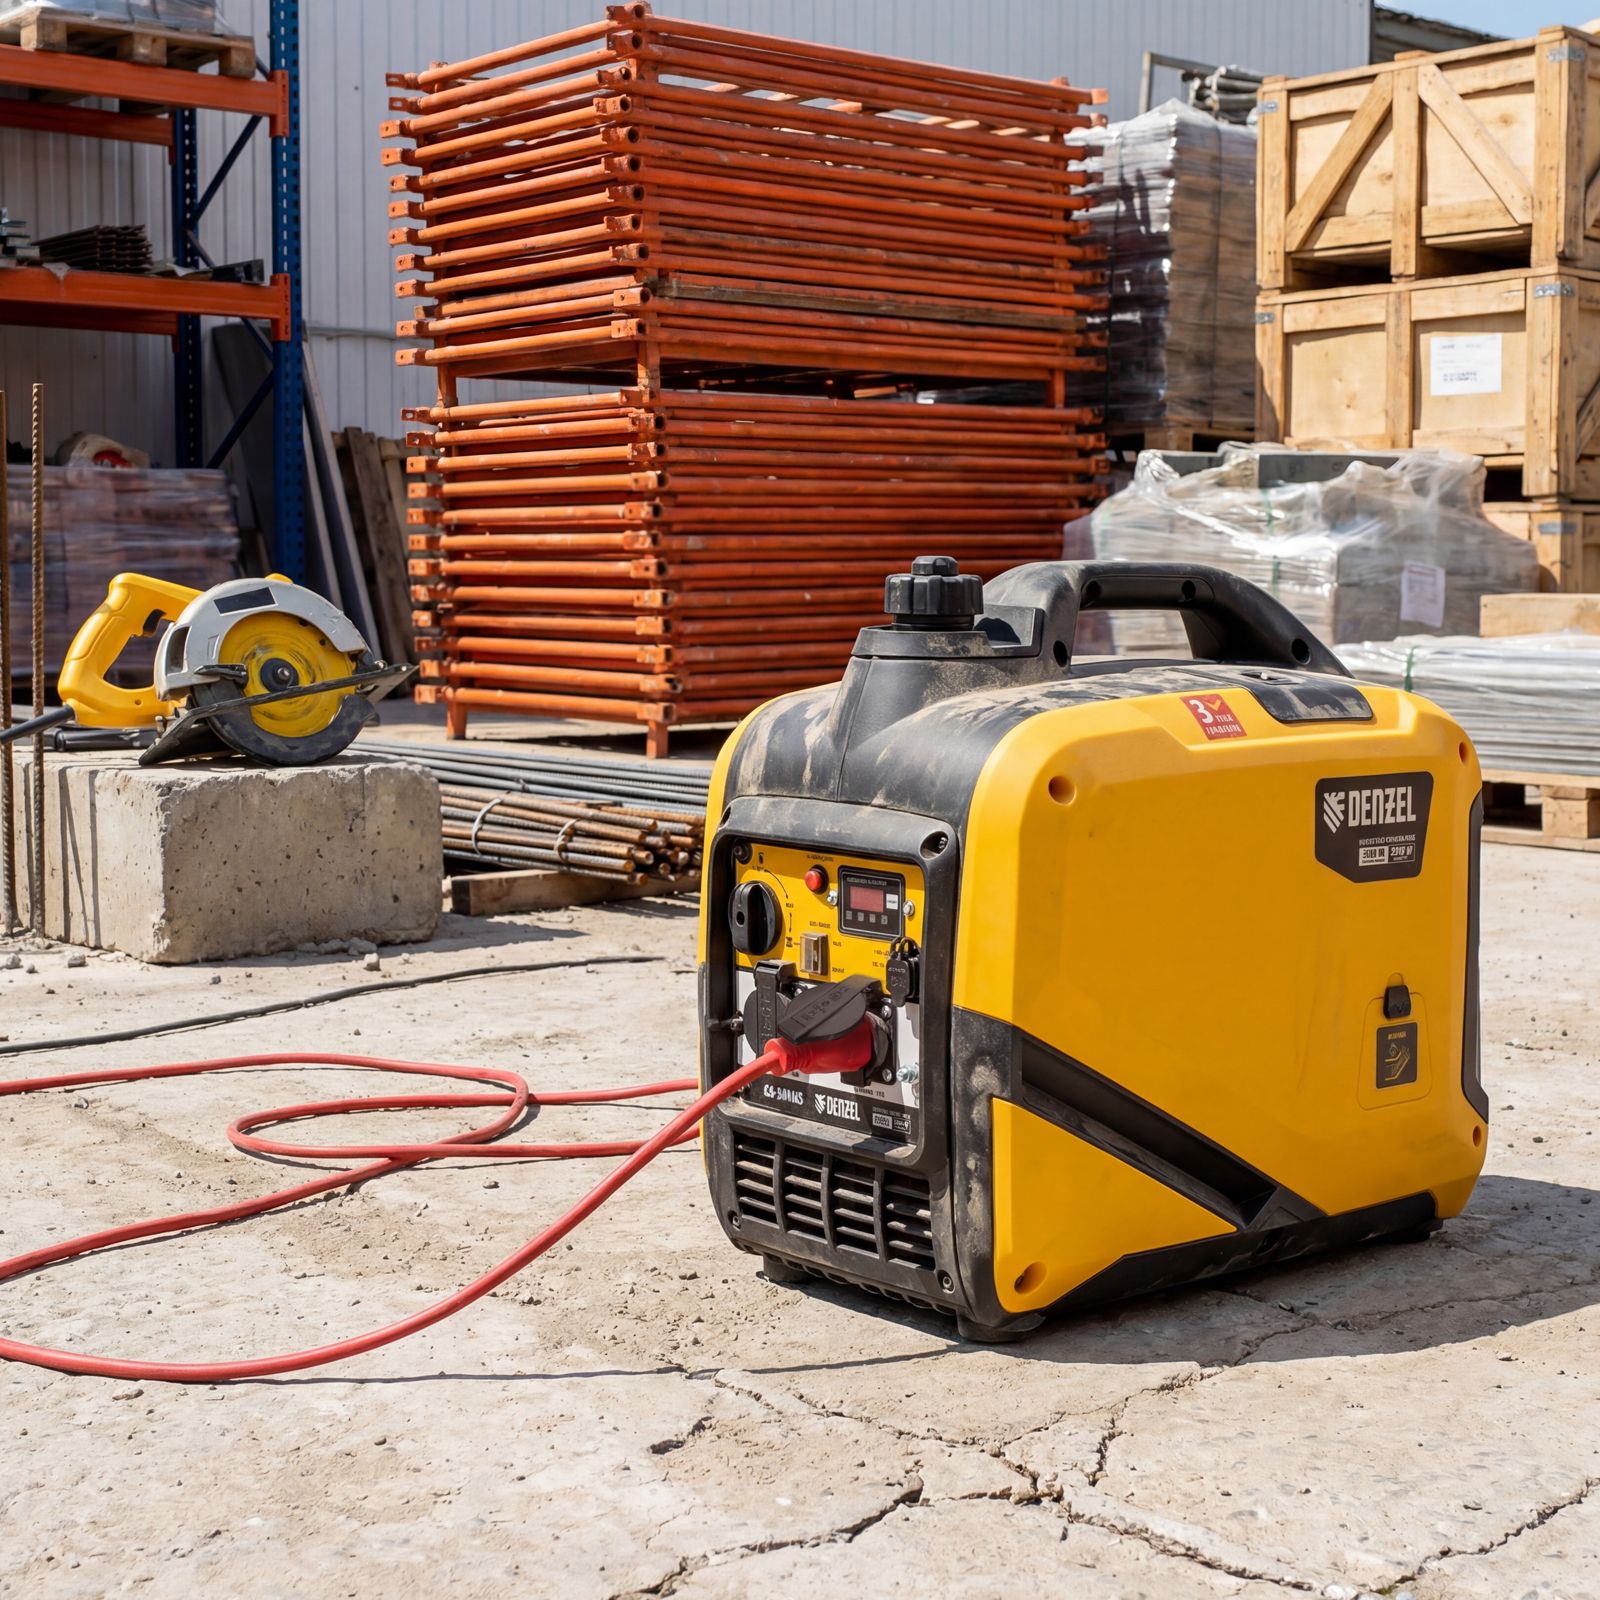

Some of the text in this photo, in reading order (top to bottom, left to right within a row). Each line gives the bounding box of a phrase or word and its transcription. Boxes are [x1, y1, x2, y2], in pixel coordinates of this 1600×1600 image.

[1188, 699, 1214, 724] 3
[1348, 786, 1417, 828] DENZEL
[826, 1095, 861, 1121] DENZEL
